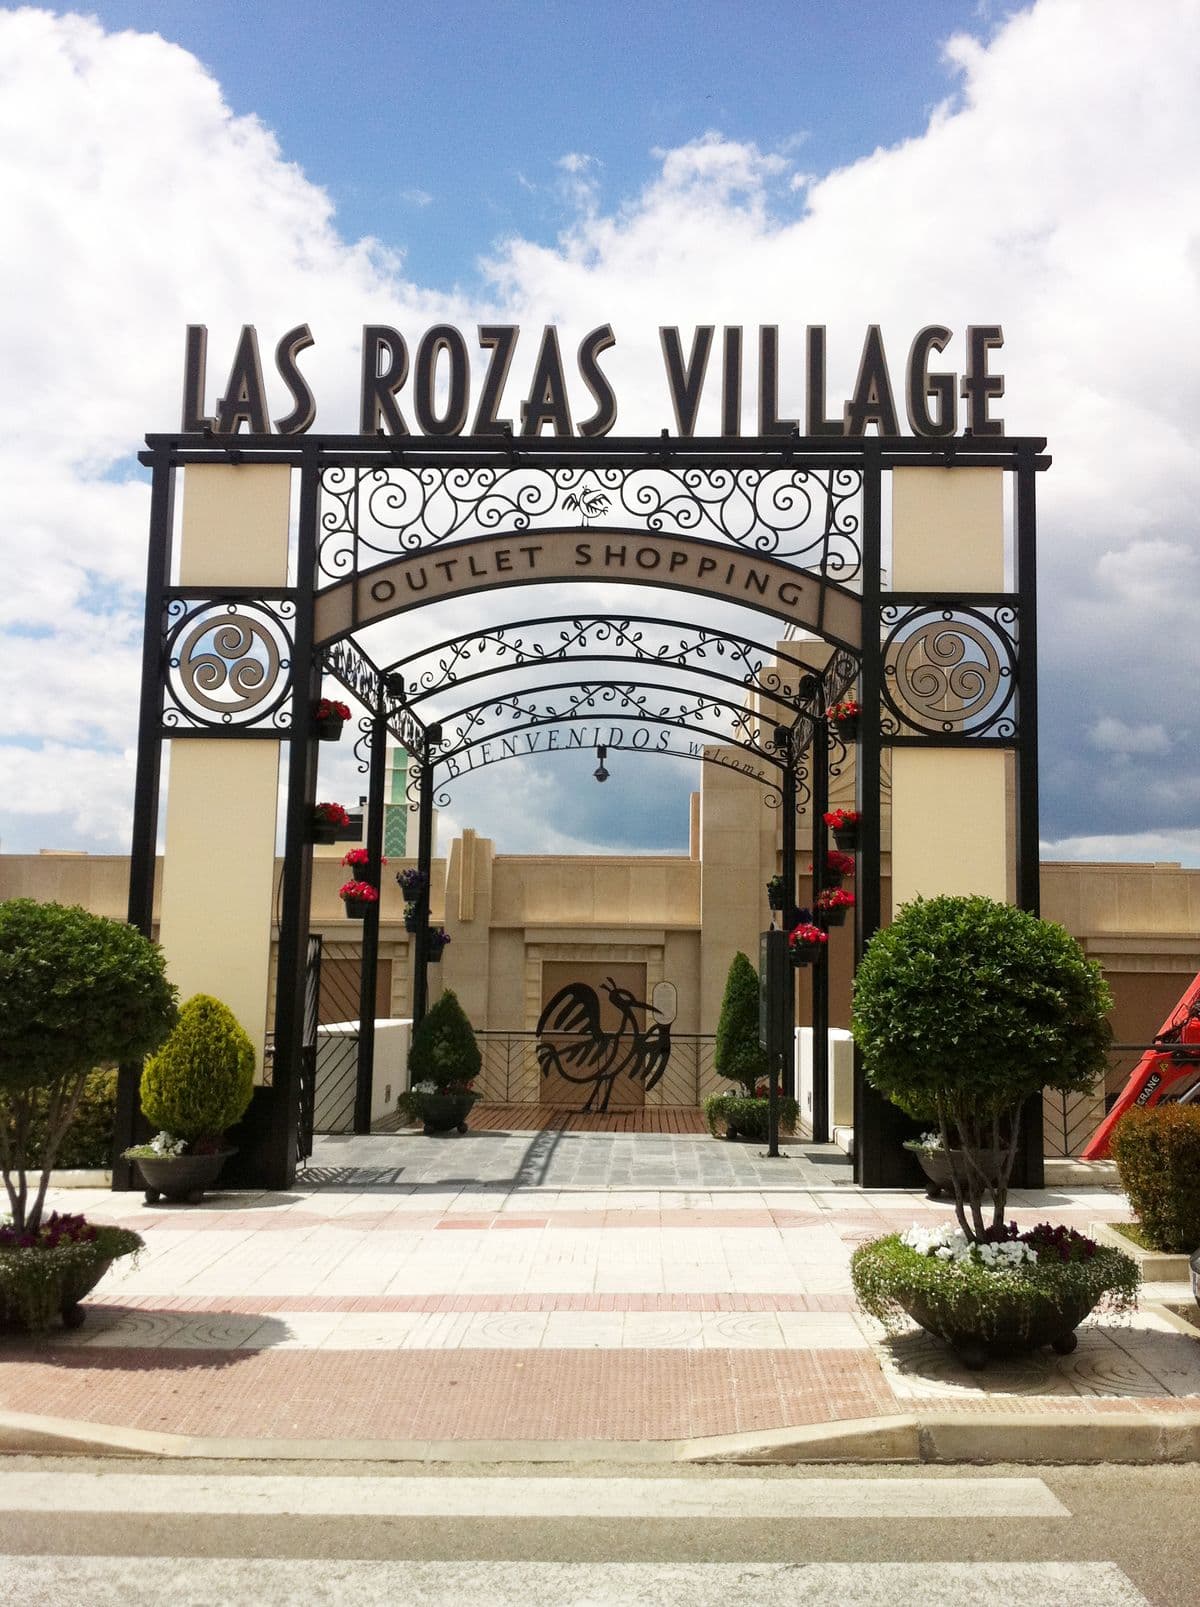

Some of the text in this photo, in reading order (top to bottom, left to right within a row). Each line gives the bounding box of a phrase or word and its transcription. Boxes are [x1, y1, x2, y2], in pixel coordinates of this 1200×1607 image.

[183, 323, 1005, 438] LAS ROZAS VILLAGE
[371, 543, 804, 607] OUTLET SHOPPING
[446, 728, 671, 779] BIENVENIDOS
